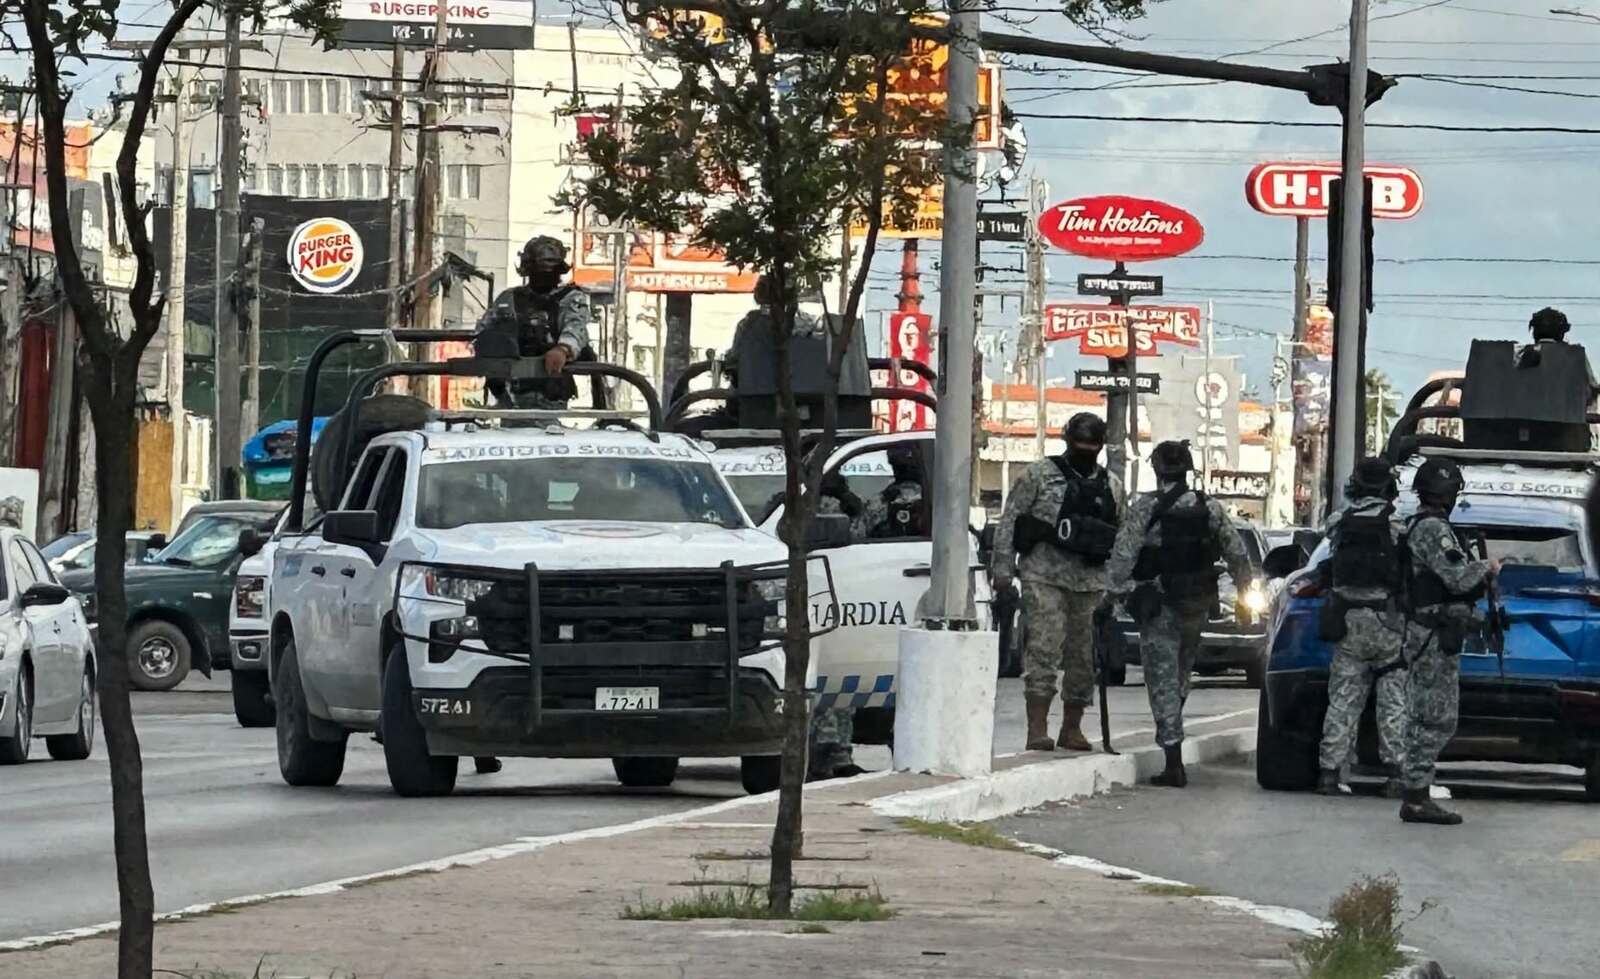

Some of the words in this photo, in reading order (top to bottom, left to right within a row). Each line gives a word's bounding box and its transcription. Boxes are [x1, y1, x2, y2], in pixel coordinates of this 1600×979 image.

[1058, 205, 1096, 232] Tim
[1099, 206, 1184, 234] Hortons
[298, 234, 352, 255] BURGER
[299, 246, 354, 273] KING
